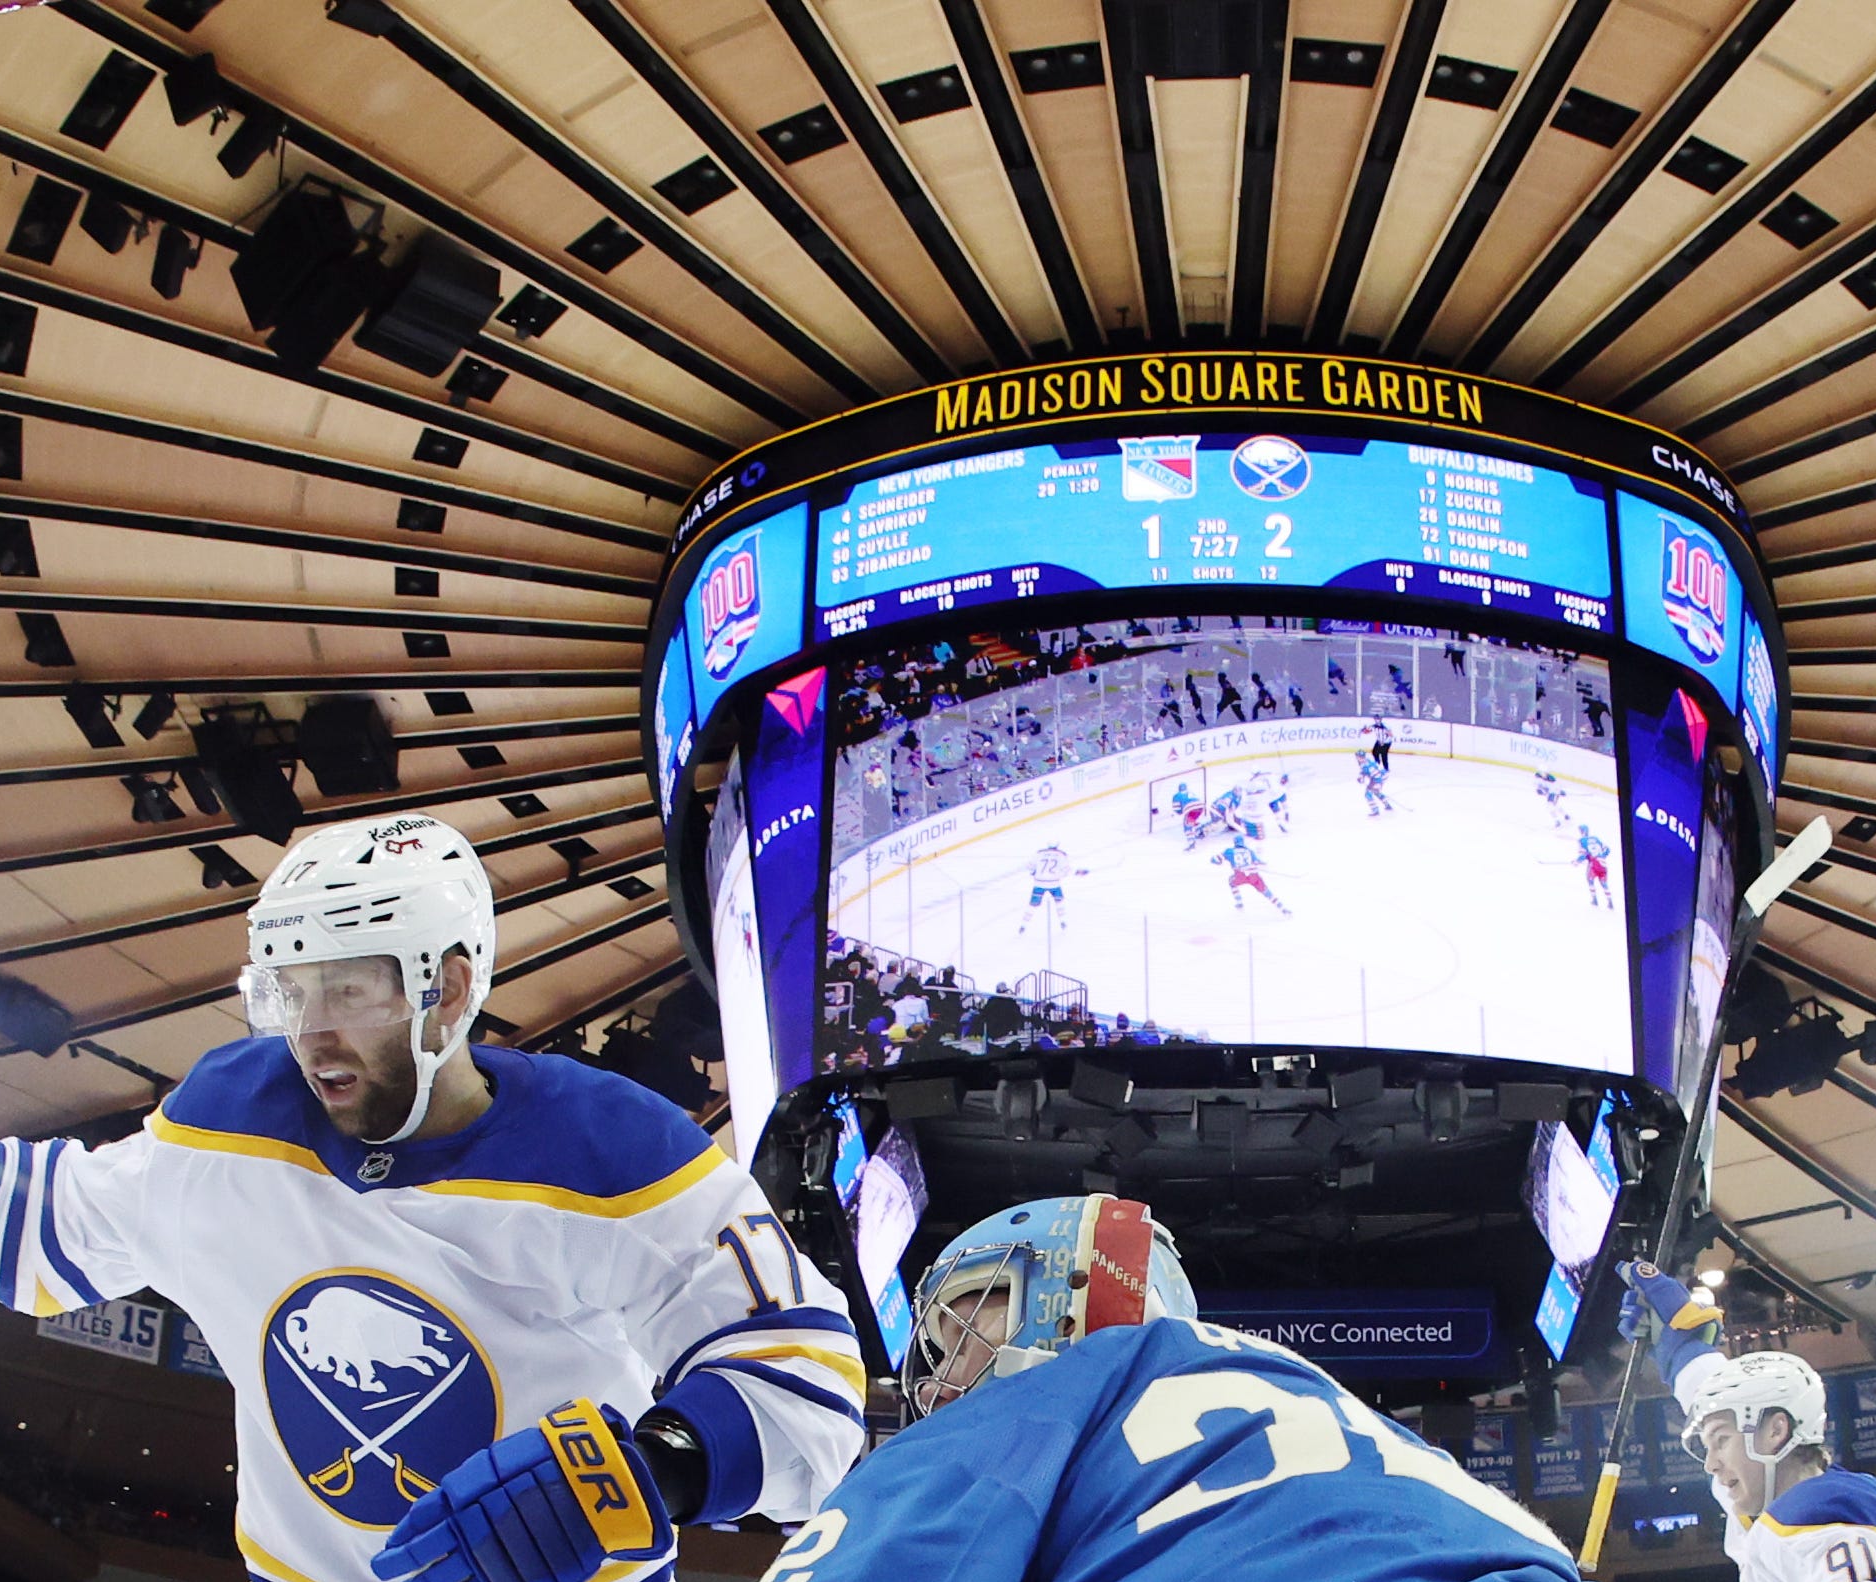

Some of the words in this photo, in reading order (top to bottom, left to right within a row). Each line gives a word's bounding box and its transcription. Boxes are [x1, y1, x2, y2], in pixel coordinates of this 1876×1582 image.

[934, 366, 1123, 434] MADISON
[1140, 358, 1305, 405] SQUARE
[1322, 360, 1483, 424] GARDEN
[878, 473, 910, 495] NEW
[911, 462, 952, 486] YORK
[954, 450, 1025, 477] RANGERS
[1043, 462, 1098, 480] PENALTY
[1408, 445, 1475, 471] BUFFALO
[1476, 454, 1534, 484] SABRES
[1444, 473, 1499, 497] NORRIS
[1652, 445, 1737, 514] CHASE
[841, 510, 851, 524] 4
[858, 488, 936, 520] SCHNEIDER
[1419, 489, 1437, 504] 17
[1445, 491, 1502, 516] ZUCKER
[832, 530, 851, 545] 44
[858, 509, 927, 539] GAVRIKOV
[1198, 519, 1227, 534] 2ND
[1447, 509, 1501, 534] DAHLIN
[857, 531, 909, 558] CUYLLE
[1141, 514, 1162, 559] 1
[1264, 513, 1293, 559] 2
[1190, 535, 1239, 558] 7:27
[1420, 526, 1440, 543] 72
[1448, 530, 1529, 559] THOMPSON
[855, 546, 931, 576] ZIBANEJAD
[1151, 567, 1168, 581] 11
[1193, 567, 1234, 580] SHOTS
[1260, 565, 1278, 580] 12
[1385, 562, 1414, 578] HITS
[1449, 550, 1490, 570] DOAN
[1012, 567, 1040, 582] HITS
[1439, 570, 1491, 590] BLOCKED
[1494, 579, 1531, 598] SHOTS
[1667, 537, 1725, 626] 100
[701, 552, 755, 643] 100
[900, 580, 952, 604] BLOCKED
[954, 574, 992, 593] SHOTS
[1017, 582, 1034, 597] 21
[824, 599, 875, 624] FACEOFFS
[1555, 592, 1607, 617] FACEOFFS
[1384, 624, 1434, 637] ULTRA
[1184, 733, 1248, 754] DELTA
[1261, 724, 1364, 744] ticketmaster
[973, 791, 1035, 823] CHASE
[762, 804, 815, 844] DELTA
[1655, 808, 1697, 852] DELTA
[888, 817, 958, 860] HYUNDAI
[282, 861, 319, 886] 17
[257, 915, 304, 930] BAUER
[716, 1211, 805, 1317] 17
[1092, 1250, 1146, 1297] RANGERS
[120, 1305, 158, 1347] 15
[1277, 1324, 1326, 1343] NYC
[1330, 1321, 1452, 1343] Connected
